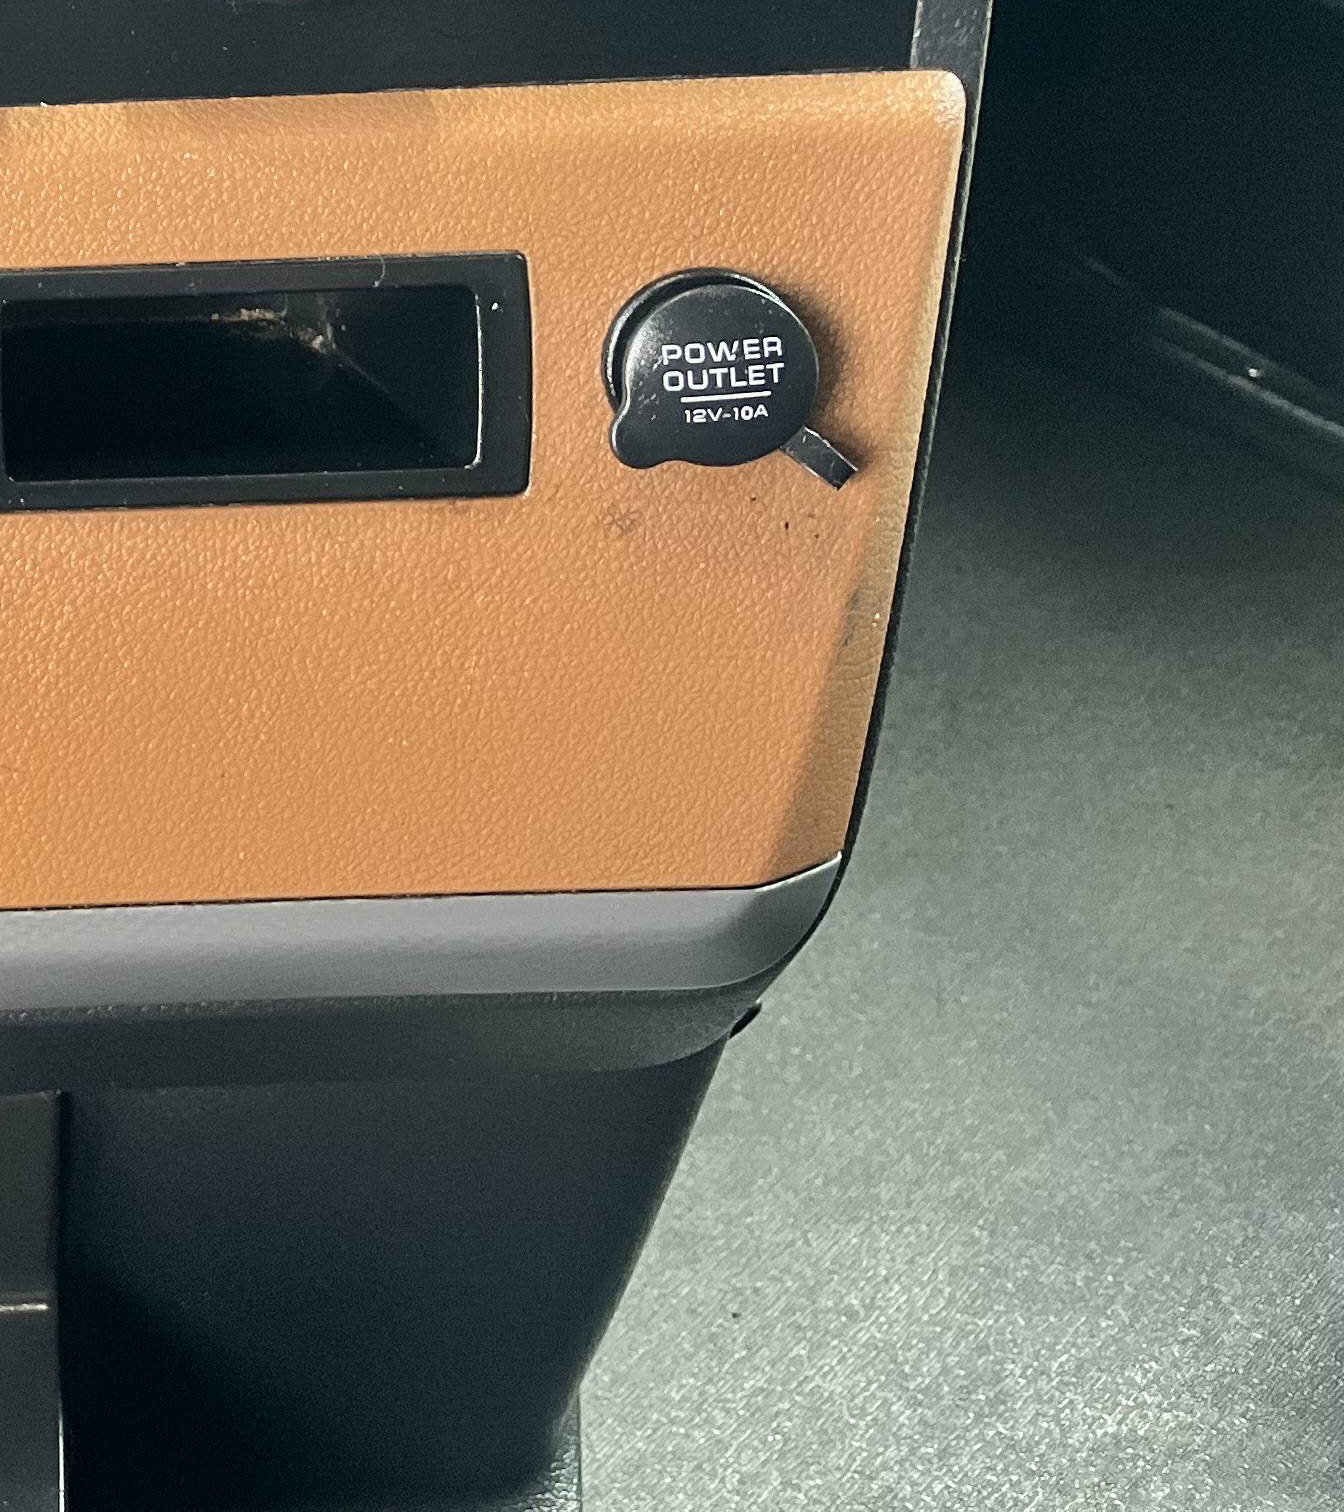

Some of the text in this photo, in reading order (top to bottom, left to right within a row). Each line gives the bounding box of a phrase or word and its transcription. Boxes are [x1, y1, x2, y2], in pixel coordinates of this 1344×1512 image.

[662, 336, 783, 366] POWER
[663, 362, 785, 392] OUTLET
[684, 403, 769, 424] 12V-10A
